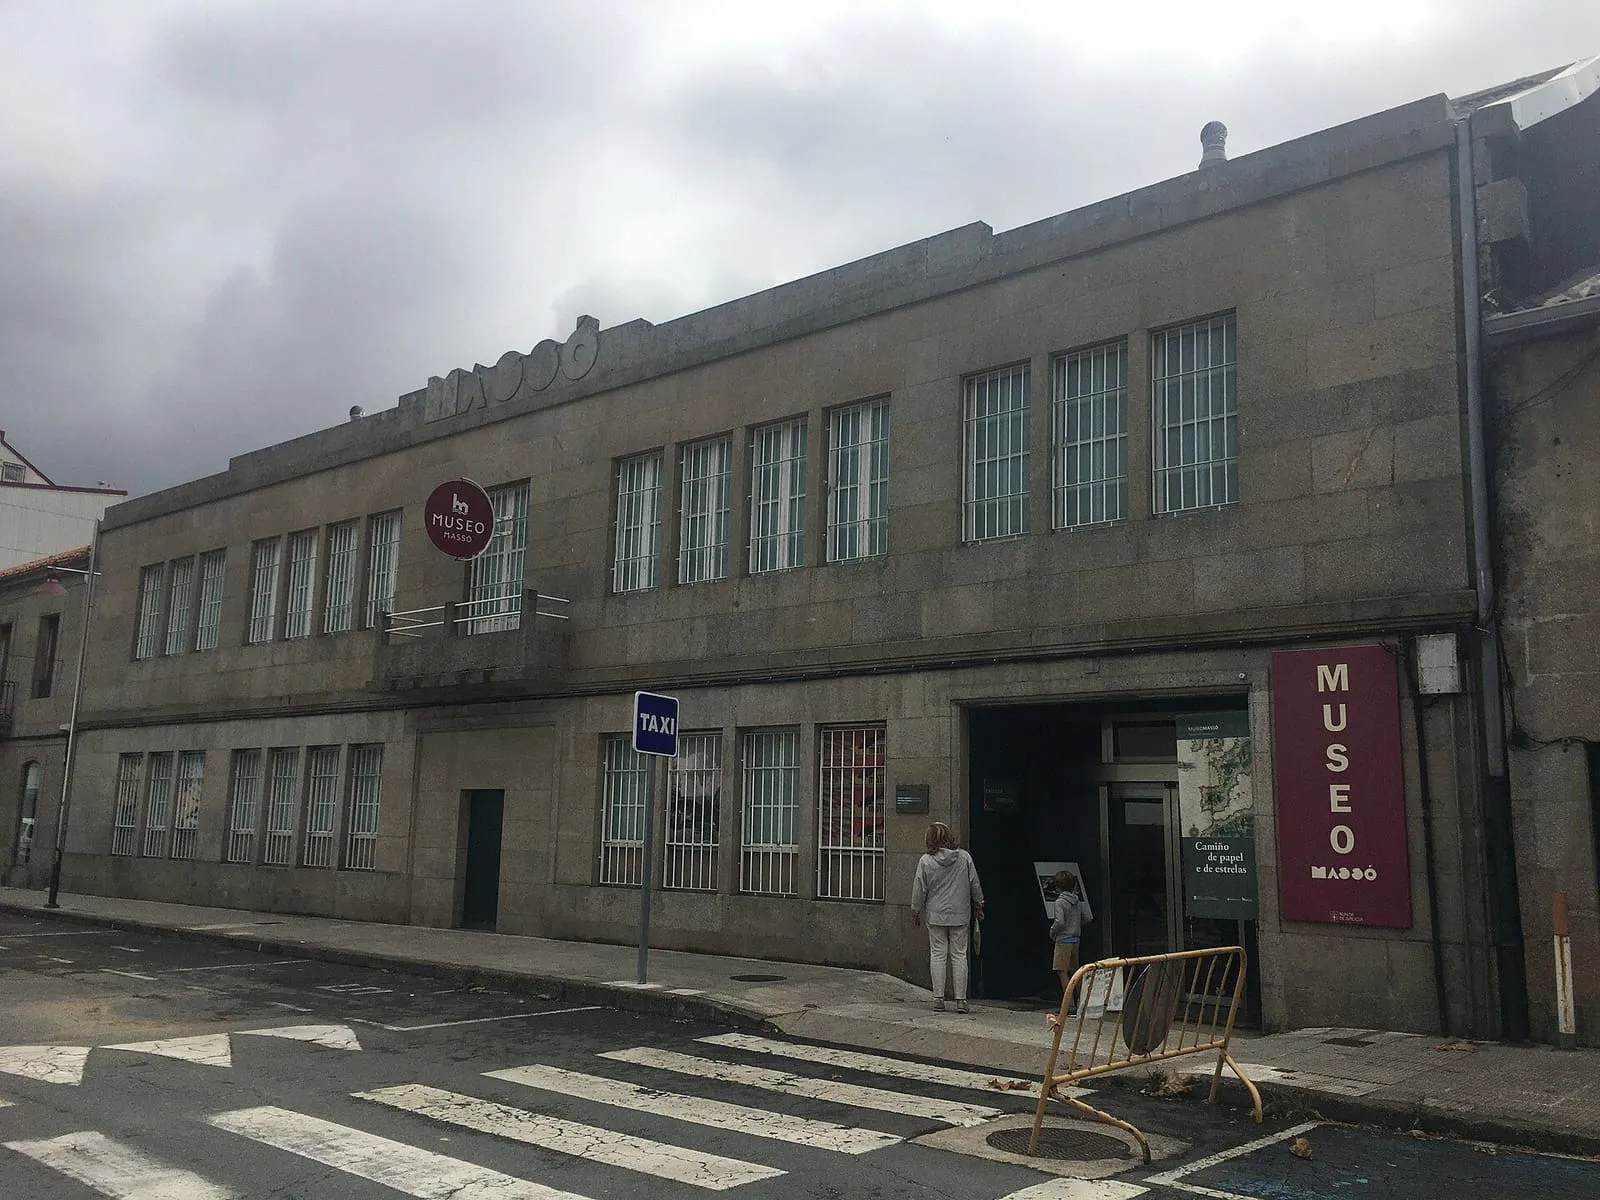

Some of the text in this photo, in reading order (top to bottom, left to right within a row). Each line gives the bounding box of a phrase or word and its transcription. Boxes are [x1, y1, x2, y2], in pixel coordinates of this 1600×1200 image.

[432, 513, 486, 534] MUSEO
[640, 712, 675, 735] TAXI
[1316, 662, 1356, 855] MUSEO
[1195, 841, 1230, 851] Camiño
[1207, 852, 1244, 864] de papel
[1203, 864, 1214, 873] de
[1215, 864, 1247, 874] estrelas
